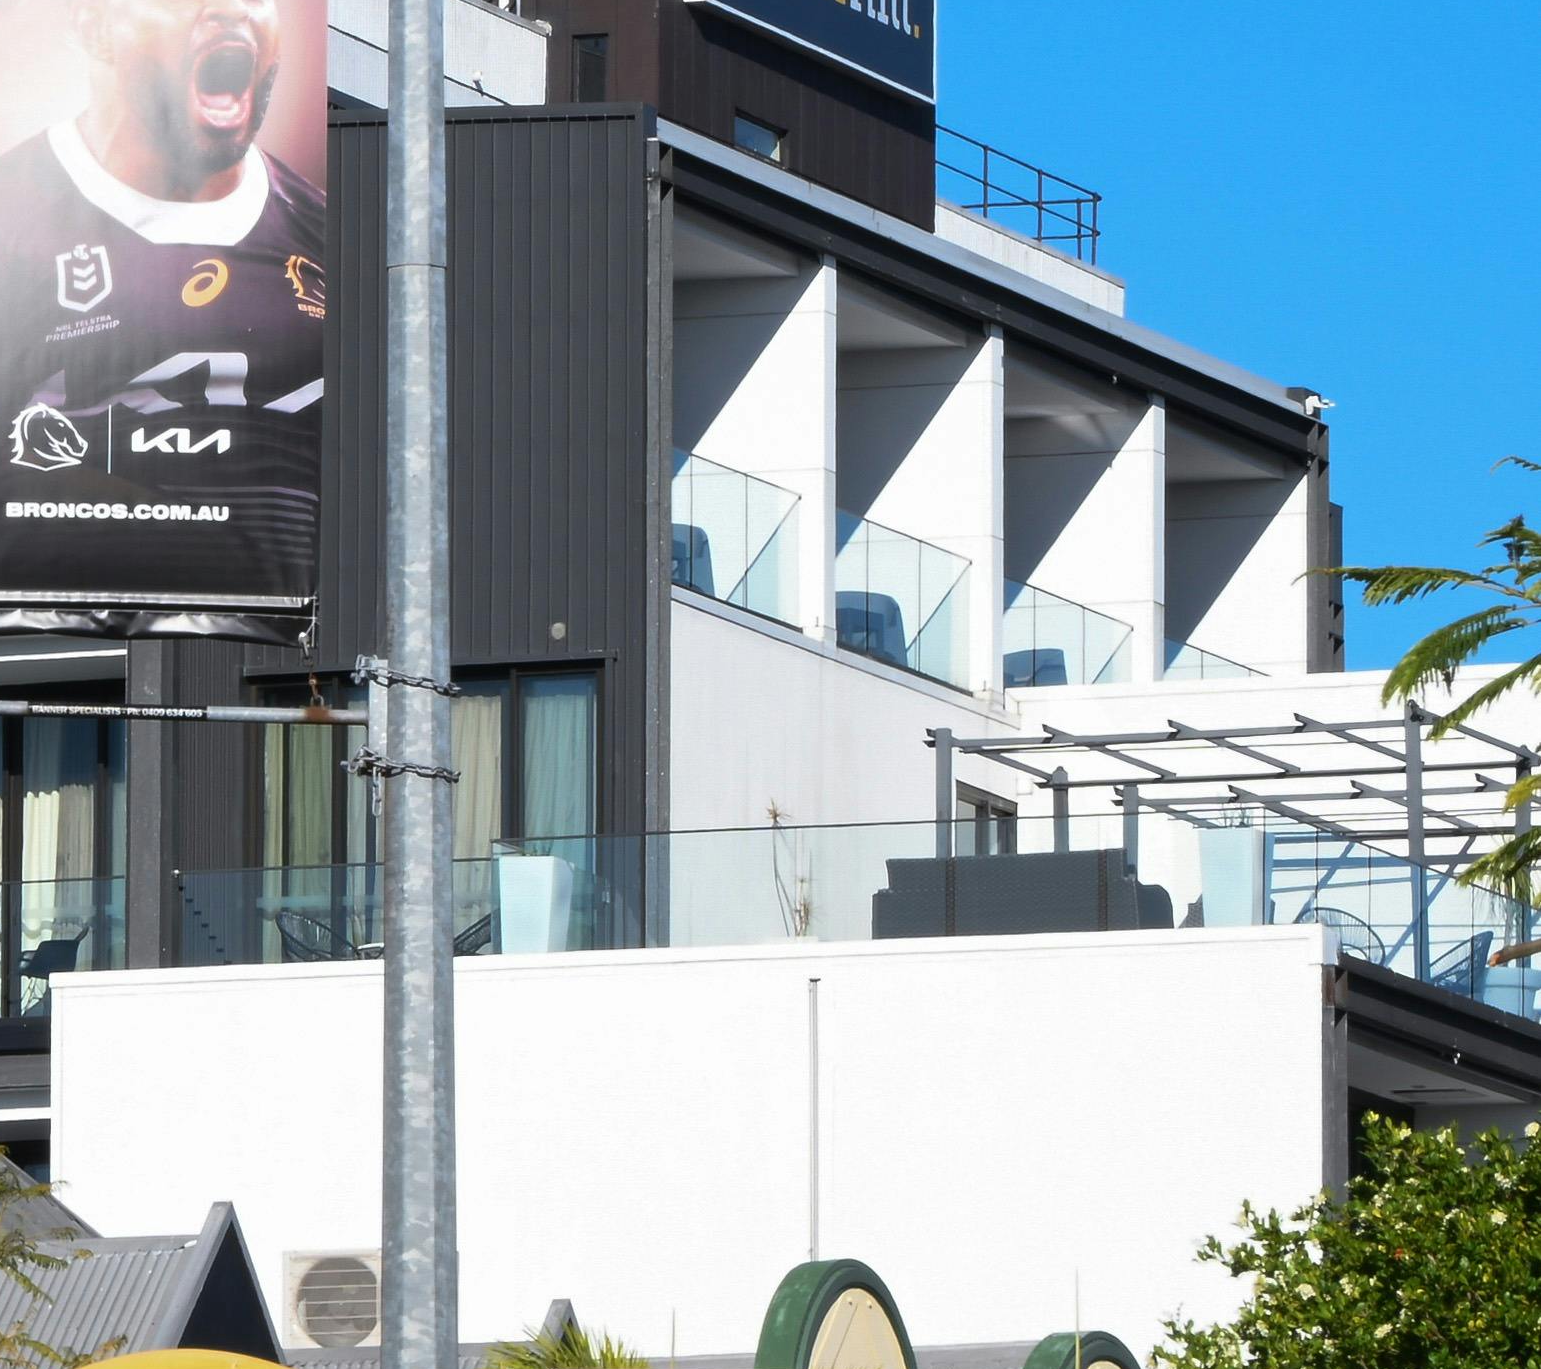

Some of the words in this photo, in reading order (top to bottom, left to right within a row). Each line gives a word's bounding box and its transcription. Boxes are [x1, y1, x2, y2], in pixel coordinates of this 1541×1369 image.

[76, 314, 112, 328] TELSTRA
[45, 319, 120, 342] PREMIERSHIP
[5, 501, 229, 522] BRONCOS.COM.AU
[31, 705, 68, 714] BANNER
[69, 705, 121, 716] SPECIALISTS
[142, 708, 165, 717] 0409
